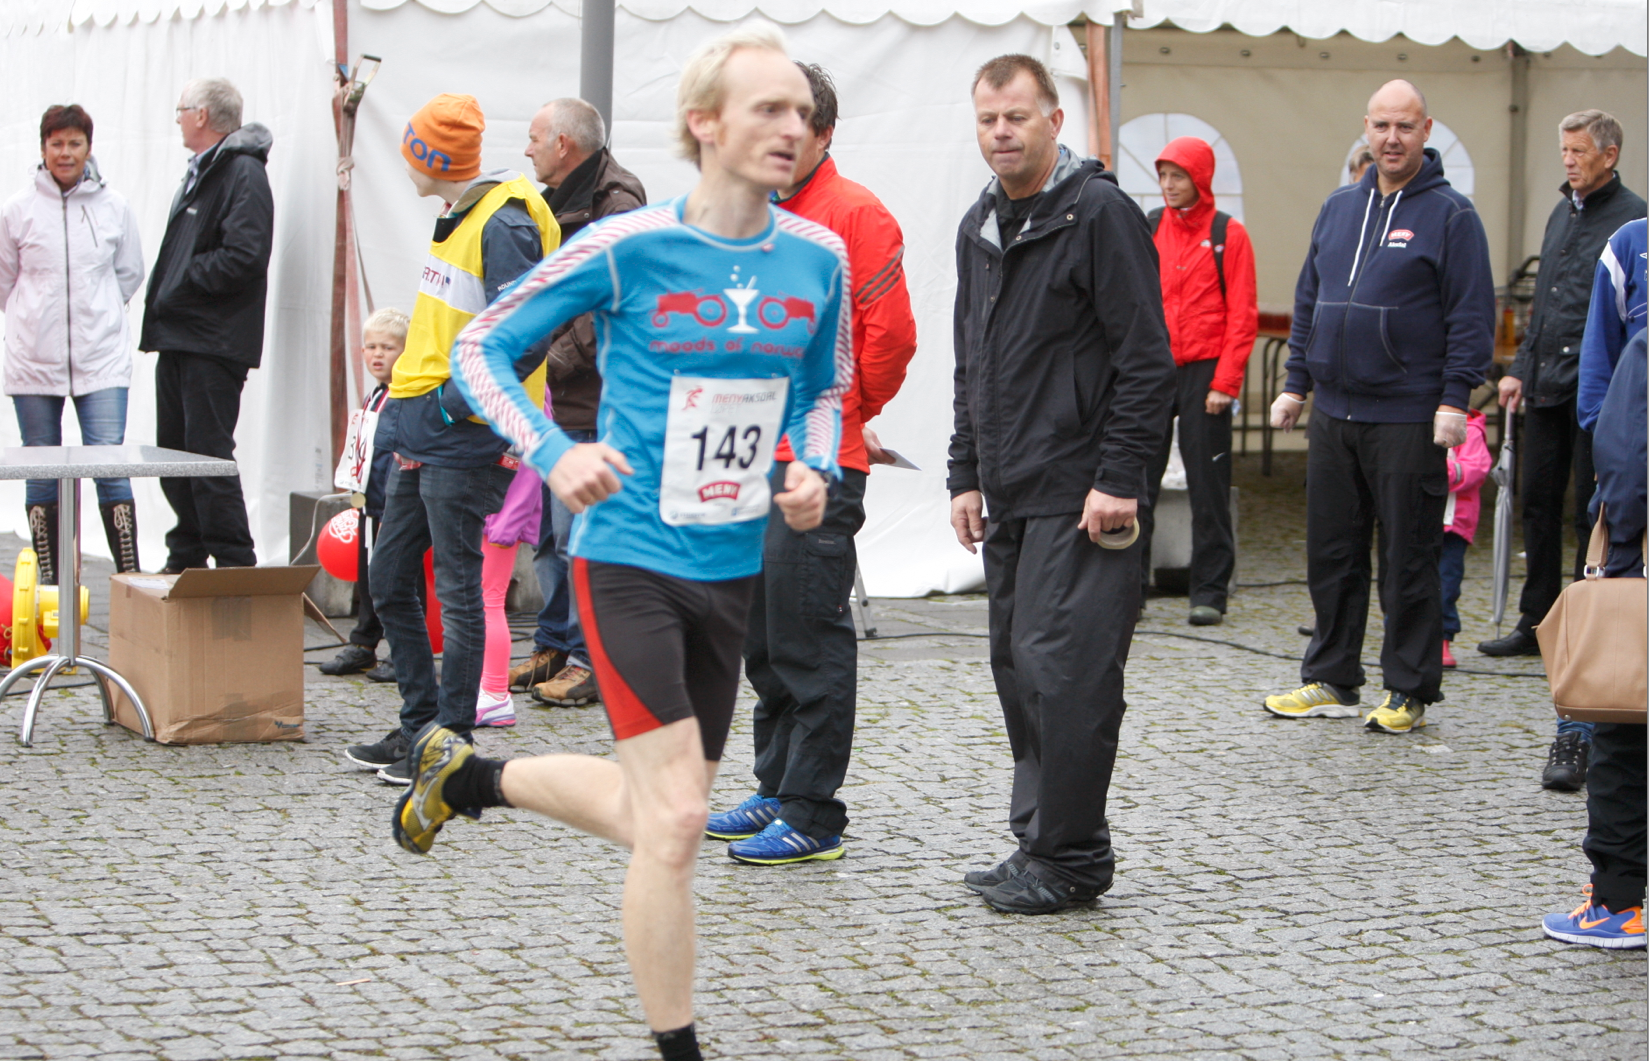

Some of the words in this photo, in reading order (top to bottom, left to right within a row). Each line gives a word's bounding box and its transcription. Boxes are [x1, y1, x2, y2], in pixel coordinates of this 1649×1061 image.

[649, 337, 716, 353] moods
[725, 335, 744, 352] of
[690, 424, 761, 471] 143
